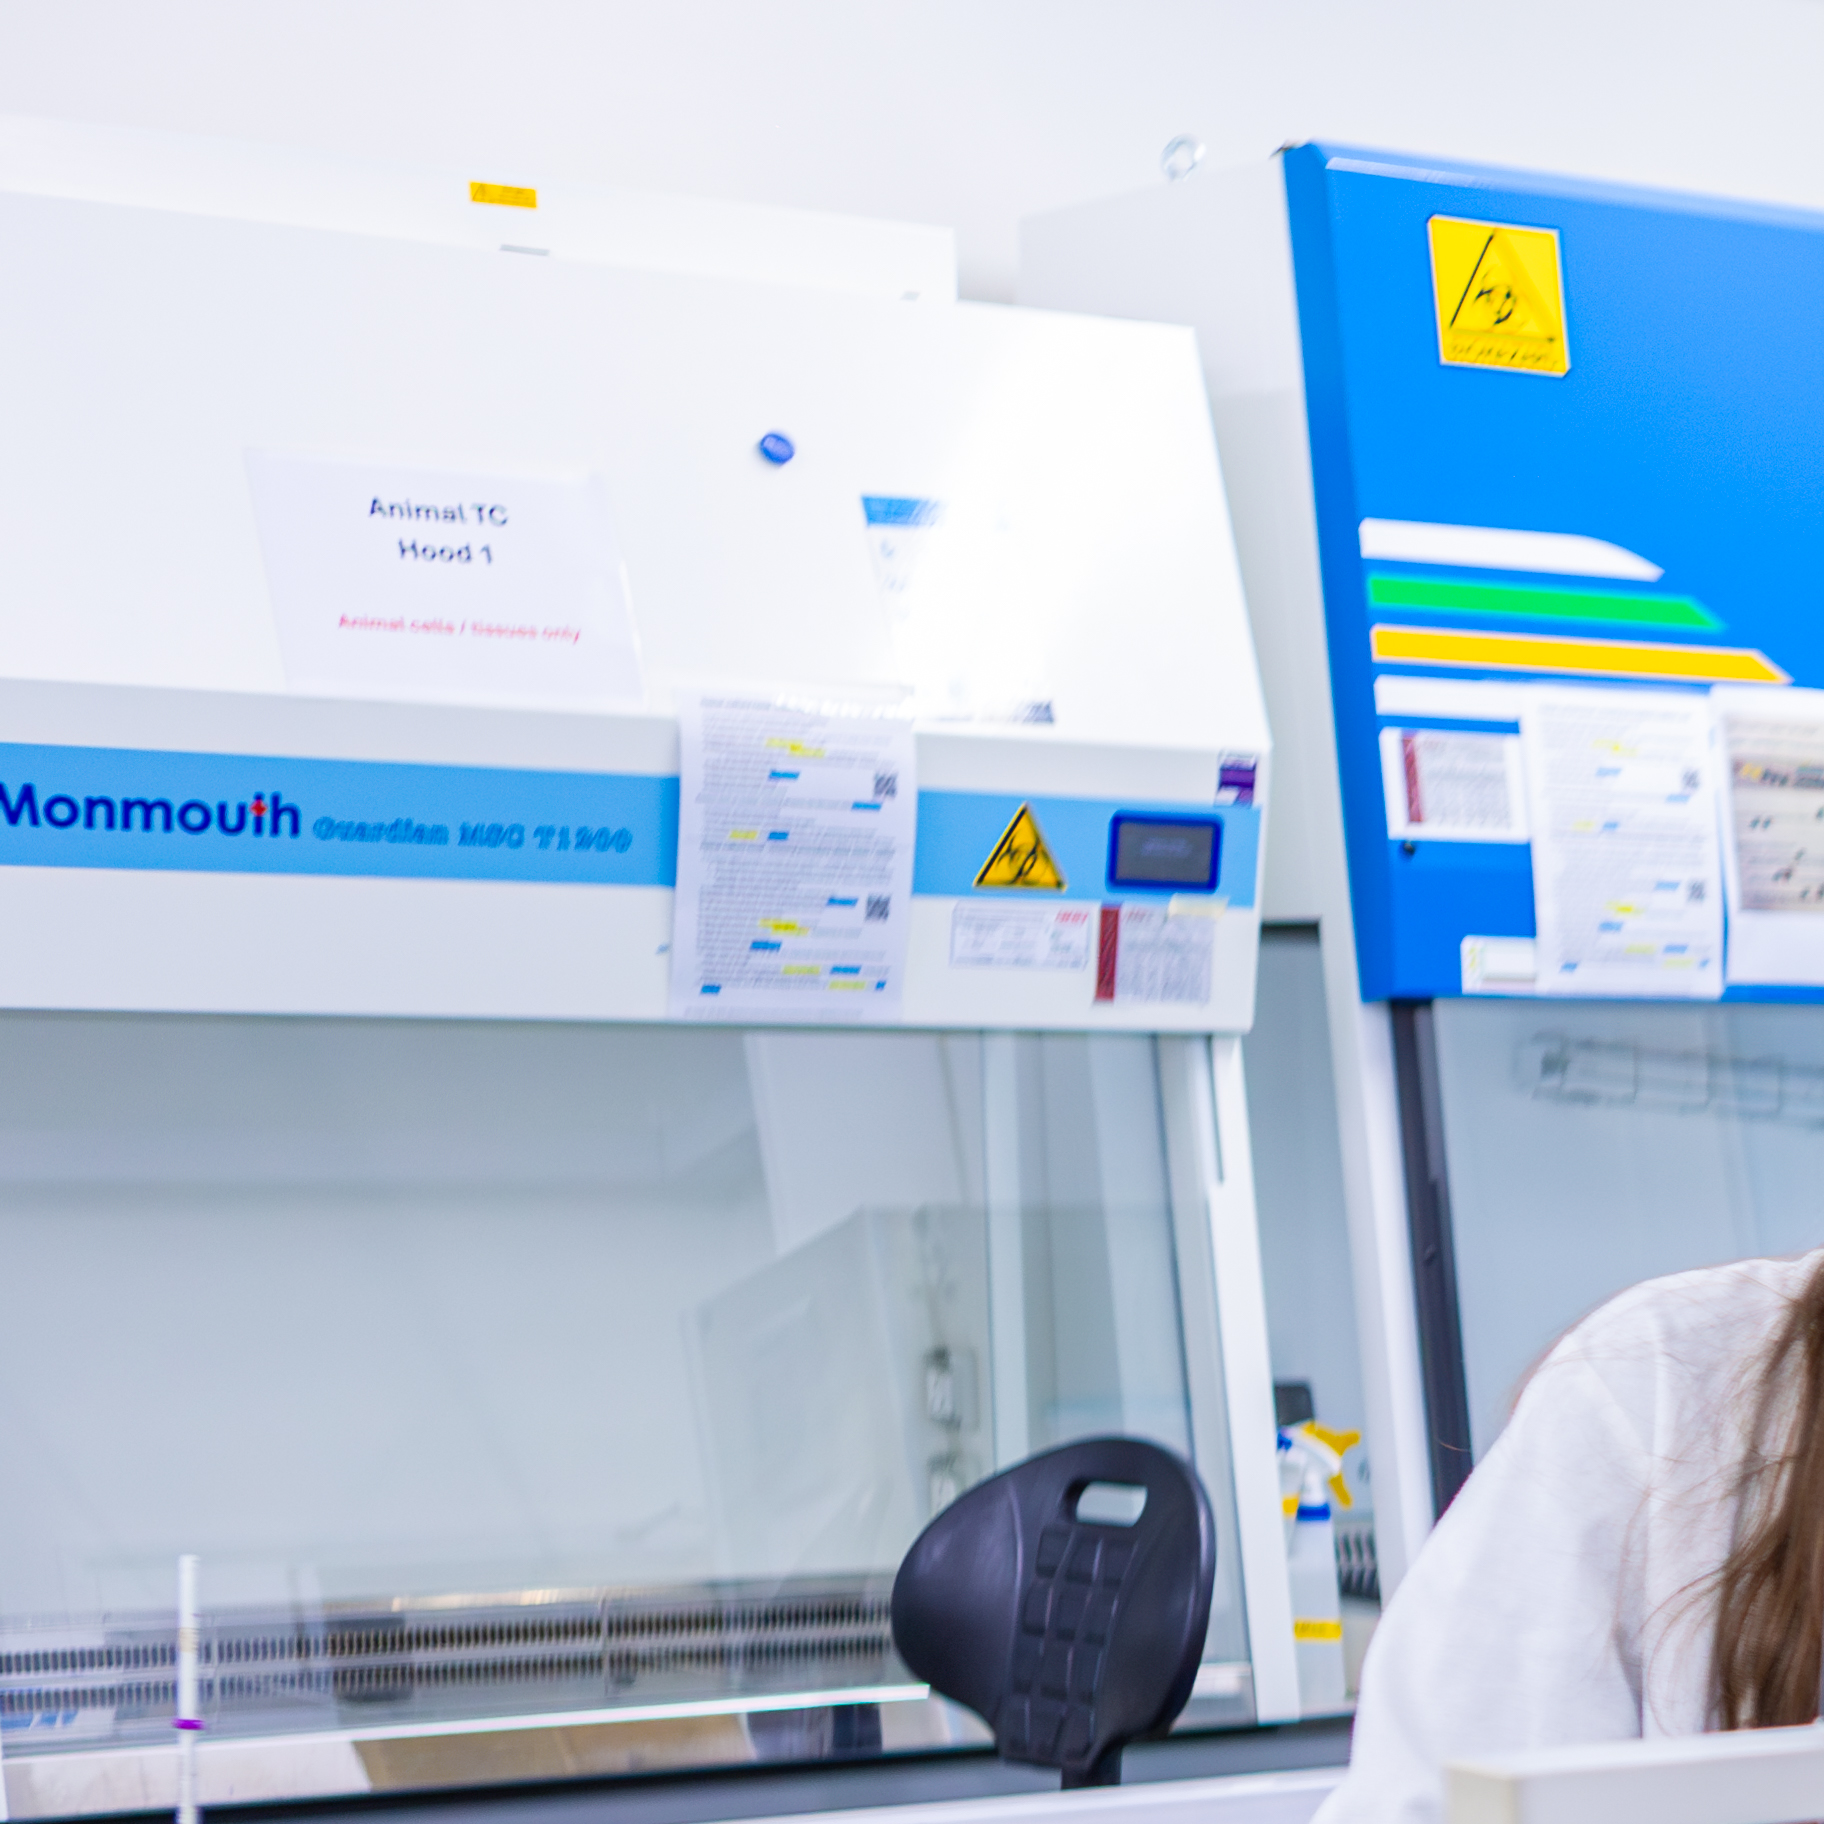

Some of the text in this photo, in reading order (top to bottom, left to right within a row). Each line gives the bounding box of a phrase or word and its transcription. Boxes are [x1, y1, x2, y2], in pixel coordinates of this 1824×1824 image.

[369, 496, 509, 527] Animal TC
[398, 538, 493, 566] Hood 1
[0, 782, 303, 838] Monmouth
